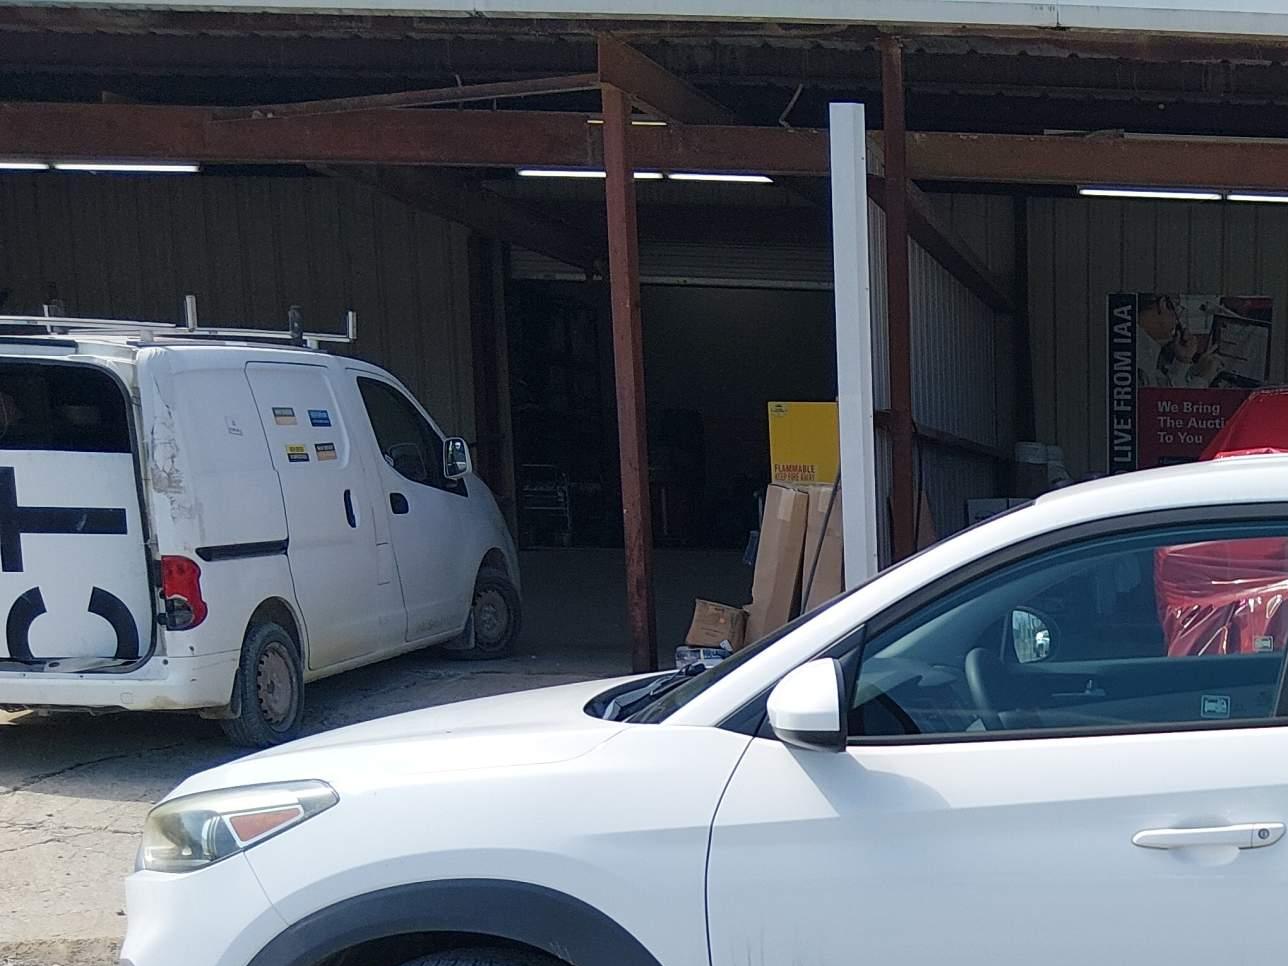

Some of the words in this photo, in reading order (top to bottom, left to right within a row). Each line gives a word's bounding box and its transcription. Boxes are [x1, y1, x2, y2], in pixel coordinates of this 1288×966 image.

[1113, 304, 1132, 343] IAA
[1113, 351, 1132, 411] FROM
[1157, 401, 1179, 413] We
[1183, 401, 1221, 416] Bring
[1157, 416, 1184, 429] The
[1188, 416, 1225, 429] Aucti
[1113, 414, 1132, 462] LIVE
[1157, 431, 1174, 443] To
[1178, 431, 1203, 443] You
[774, 463, 816, 474] FLAMMABLE
